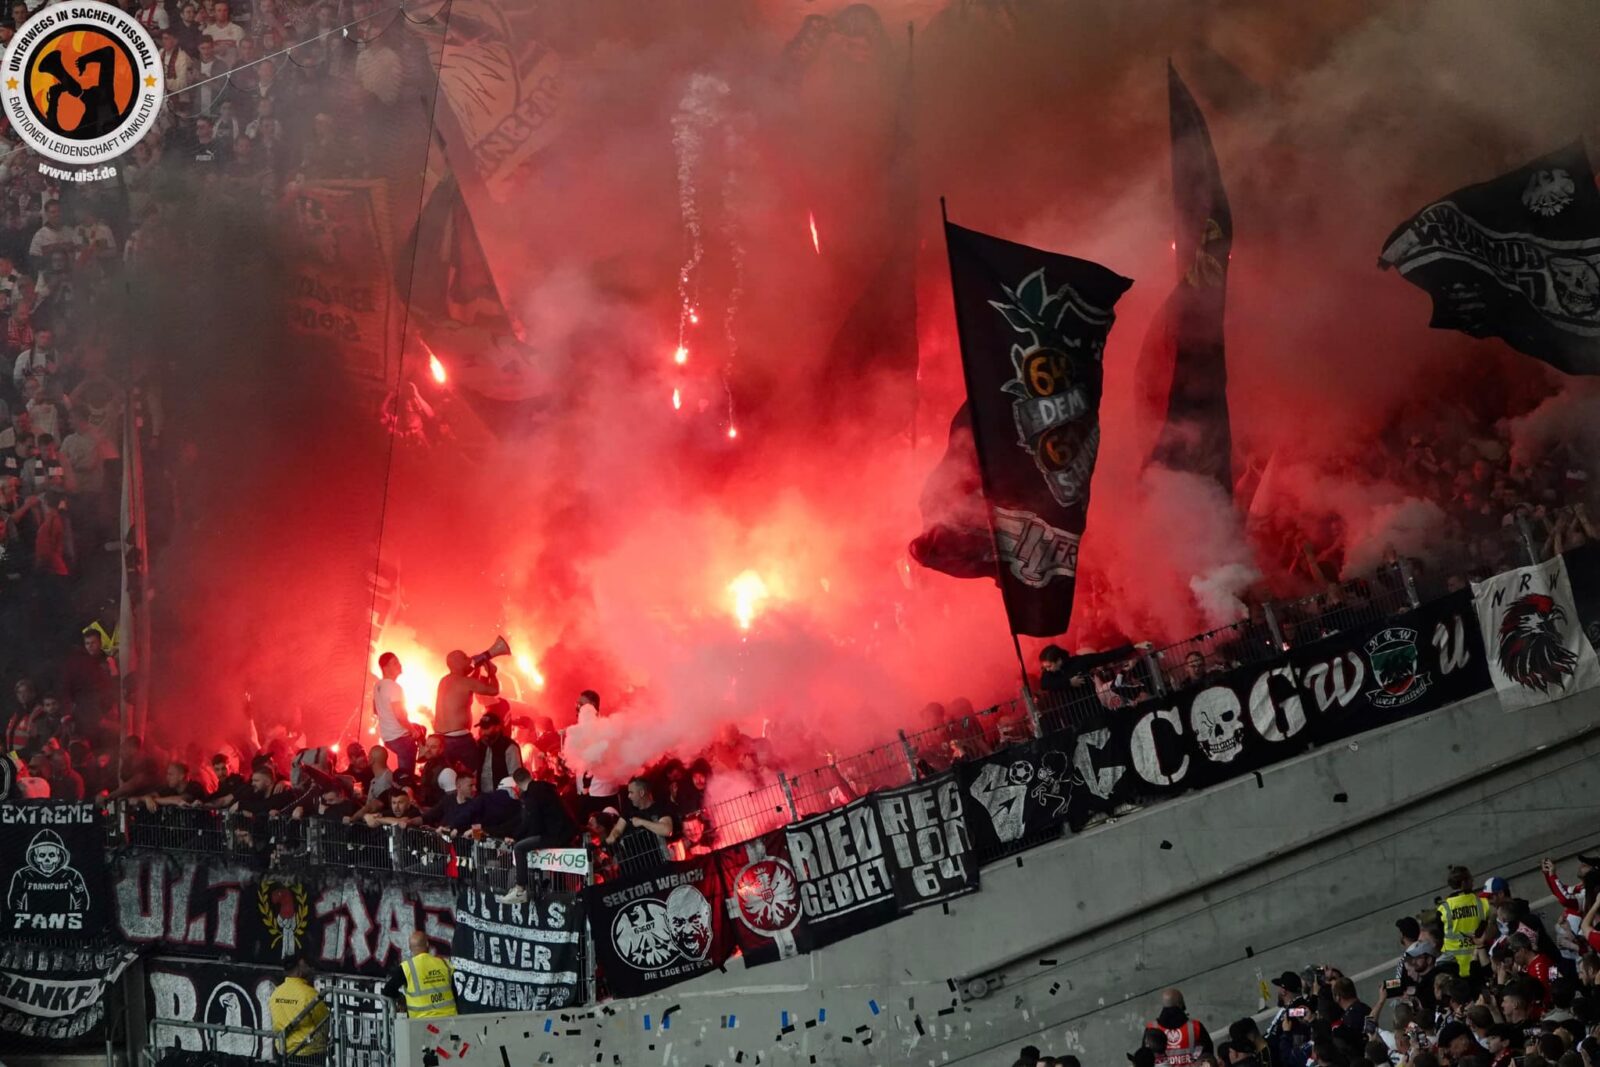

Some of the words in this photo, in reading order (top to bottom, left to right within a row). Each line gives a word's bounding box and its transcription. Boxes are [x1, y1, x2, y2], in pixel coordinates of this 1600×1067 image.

[1038, 388, 1086, 426] DEM
[2, 804, 94, 824] EXTREME
[787, 805, 883, 882] RIED
[27, 882, 69, 890] FRANKFURT
[800, 858, 893, 917] GEBIET
[912, 855, 968, 897] 64
[466, 886, 566, 929] ULTRAS
[602, 881, 654, 908] SEKTOR
[14, 913, 83, 930] FANS
[1452, 905, 1479, 920] SECURITY
[473, 930, 552, 971] NEVER
[644, 971, 658, 981] DIE
[660, 966, 680, 978] LAGE
[275, 998, 299, 1006] SECURITY
